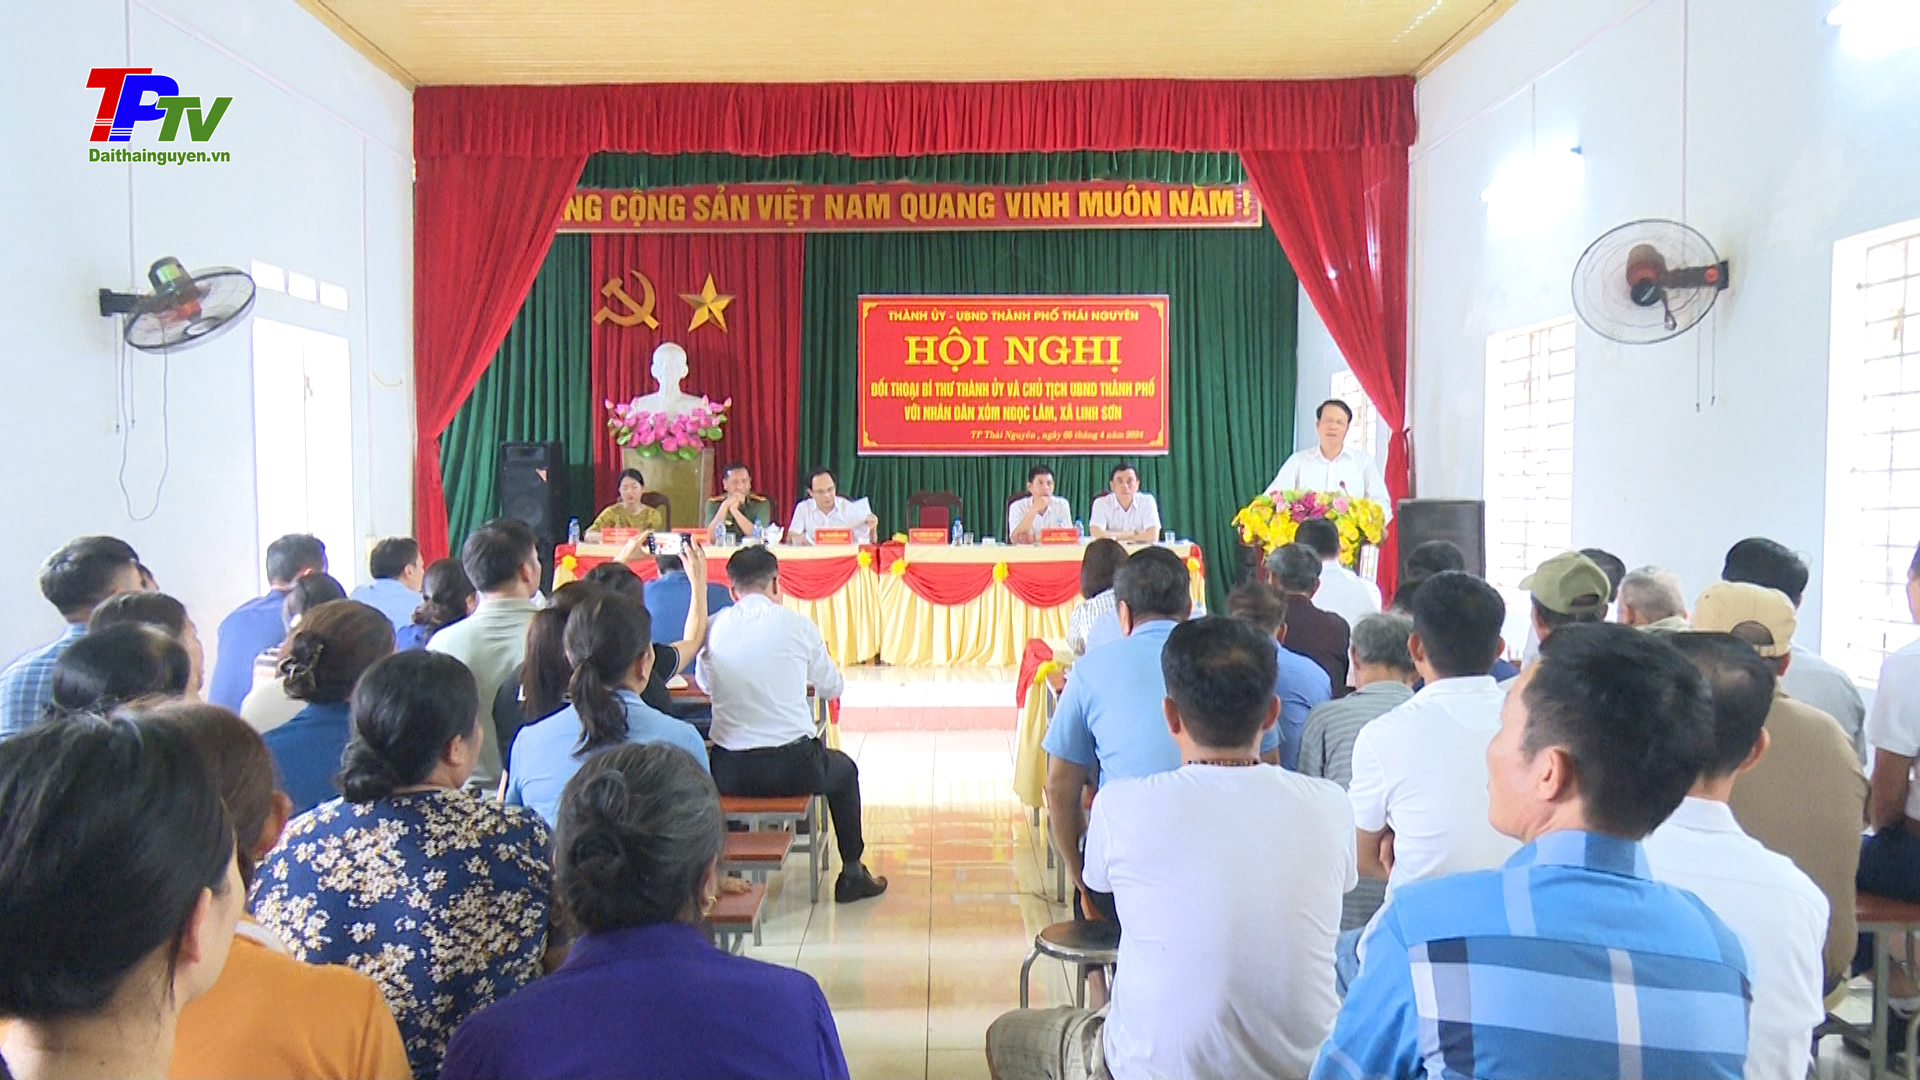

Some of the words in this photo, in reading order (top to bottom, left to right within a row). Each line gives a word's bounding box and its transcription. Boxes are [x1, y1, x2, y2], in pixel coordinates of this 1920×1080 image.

[563, 193, 602, 222] NG
[610, 188, 687, 228] CỘNG
[692, 185, 750, 221] SẢN
[757, 188, 814, 227] VIỆT
[825, 193, 891, 220] NAM
[900, 191, 996, 223] QUANG
[1005, 191, 1070, 219] VINH
[1078, 184, 1162, 218] MUÔN
[1168, 185, 1235, 218] NĂM
[888, 309, 928, 321] THÀNH
[931, 307, 946, 321] ỦY
[956, 310, 989, 321] UBND
[991, 309, 1031, 321] THÀNH
[1034, 306, 1060, 321] PHỐ
[1062, 309, 1089, 321] THÁI
[1091, 308, 1139, 321] NGUYÊN
[904, 326, 990, 373] HỘI
[1003, 336, 1122, 373] NGHỊ
[890, 382, 920, 400] THOẠI
[922, 379, 932, 397] BÍ
[934, 380, 955, 397] THƯ
[956, 379, 990, 397] THÀNH
[991, 376, 1005, 397] ỦY
[1006, 379, 1020, 397] VÀ
[1022, 376, 1043, 397] CHỦ
[1045, 382, 1068, 400] TỊCH
[1070, 382, 1098, 397] UBND
[1100, 379, 1133, 397] THÀNH
[1135, 376, 1156, 397] PHỐ
[904, 403, 921, 421] VỚI
[923, 403, 952, 421] NHÂN
[954, 403, 976, 421] DÂN
[977, 402, 1001, 421] XÓM
[1003, 406, 1031, 424] NGỌC
[1059, 402, 1074, 421] XÃ
[1075, 406, 1100, 421] LINH
[1101, 403, 1123, 421] SƠN
[970, 430, 983, 439] TP
[984, 430, 1004, 439] Thái
